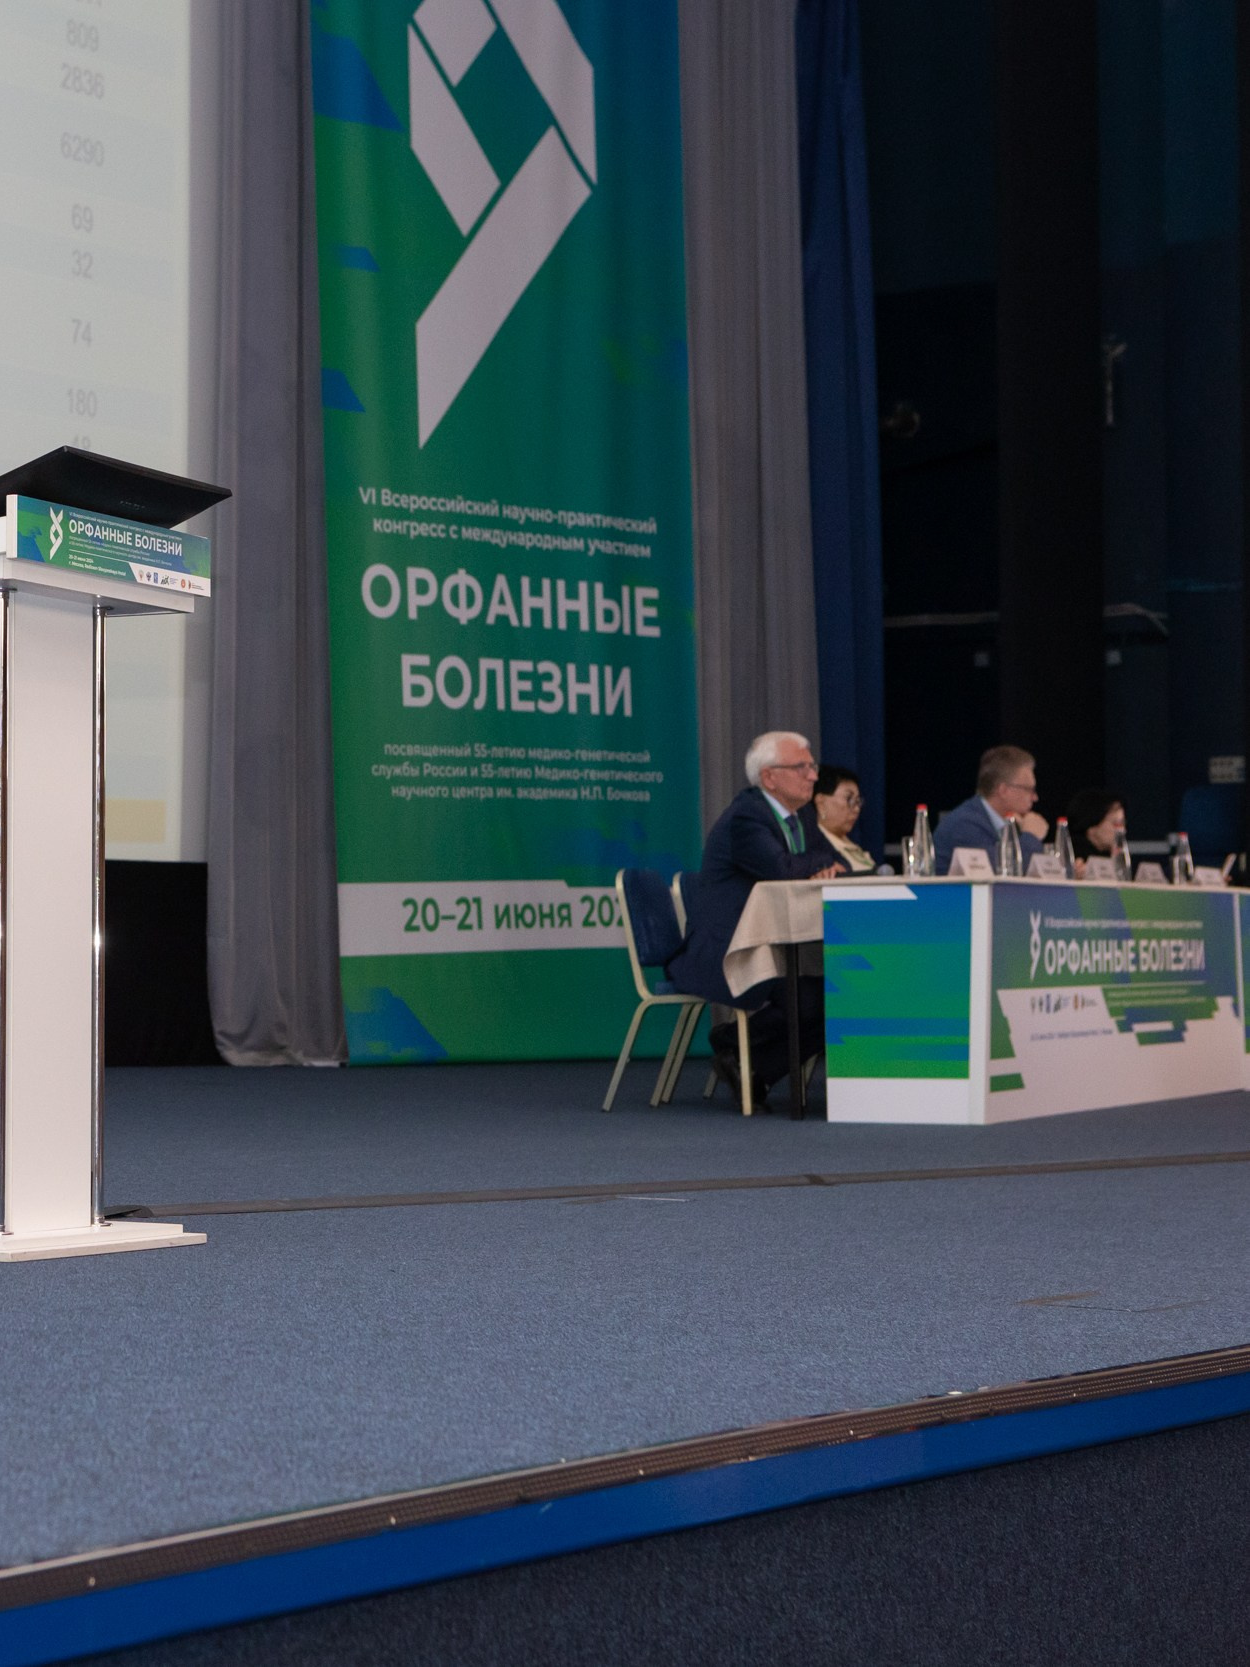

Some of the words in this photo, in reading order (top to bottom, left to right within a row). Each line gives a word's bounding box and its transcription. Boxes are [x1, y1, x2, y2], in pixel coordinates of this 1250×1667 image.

[66, 18, 100, 52] 809
[60, 63, 105, 100] 2836
[60, 132, 105, 168] 6290
[71, 203, 95, 233] 69
[71, 249, 95, 280] 32
[71, 318, 94, 347] 74
[67, 387, 97, 416] 180
[358, 486, 376, 505] VI
[380, 488, 499, 517] Всероссийский
[502, 503, 657, 535] научно-практический
[68, 519, 133, 546] ОРФАННЫЕ
[134, 533, 183, 557] БОЛЕЗНИ
[373, 518, 446, 540] конгресс
[449, 524, 459, 539] с
[461, 525, 585, 551] международным
[587, 537, 651, 559] участием
[361, 563, 662, 638] ОРФАННЫЕ
[400, 652, 633, 718] БОЛЕЗНИ
[383, 742, 471, 758] посвященный
[474, 742, 526, 759] 55-летию
[371, 761, 420, 779] службы
[423, 763, 468, 778] России
[470, 767, 478, 777] и
[481, 763, 532, 779] 55-летию
[391, 785, 449, 801] научного
[452, 786, 494, 801] центра
[517, 787, 578, 801] академика
[494, 902, 572, 929] июня
[1044, 938, 1137, 977] ОРФАННЫЕ
[1139, 938, 1206, 973] БОЛЕЗНИ
